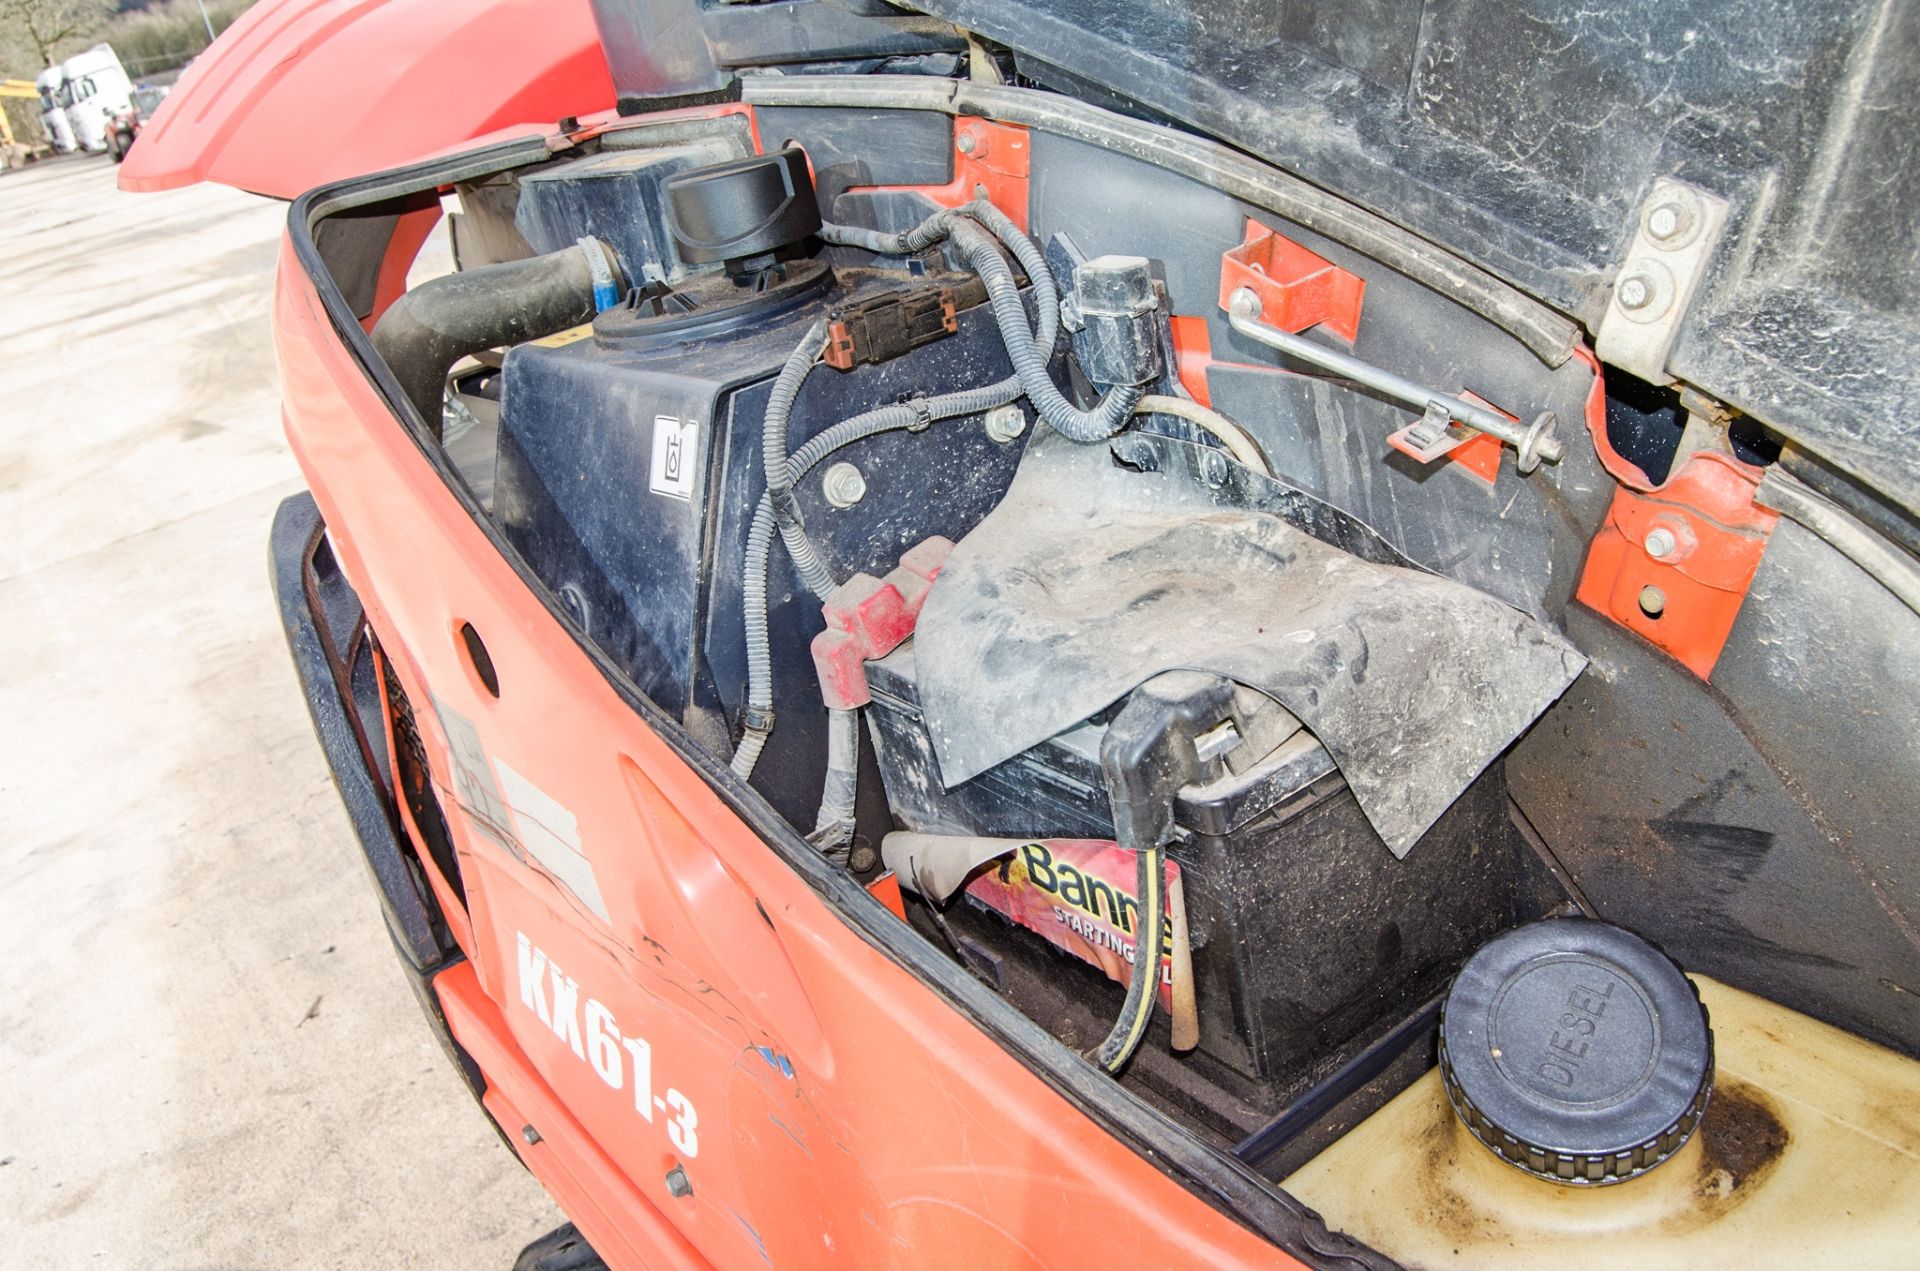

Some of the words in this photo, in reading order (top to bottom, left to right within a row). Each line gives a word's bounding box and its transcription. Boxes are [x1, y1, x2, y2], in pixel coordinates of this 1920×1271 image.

[1021, 843, 1171, 957] Bann
[1053, 906, 1136, 964] STARTING
[516, 930, 698, 1158] KX61-3
[1537, 982, 1615, 1088] DIESEL
